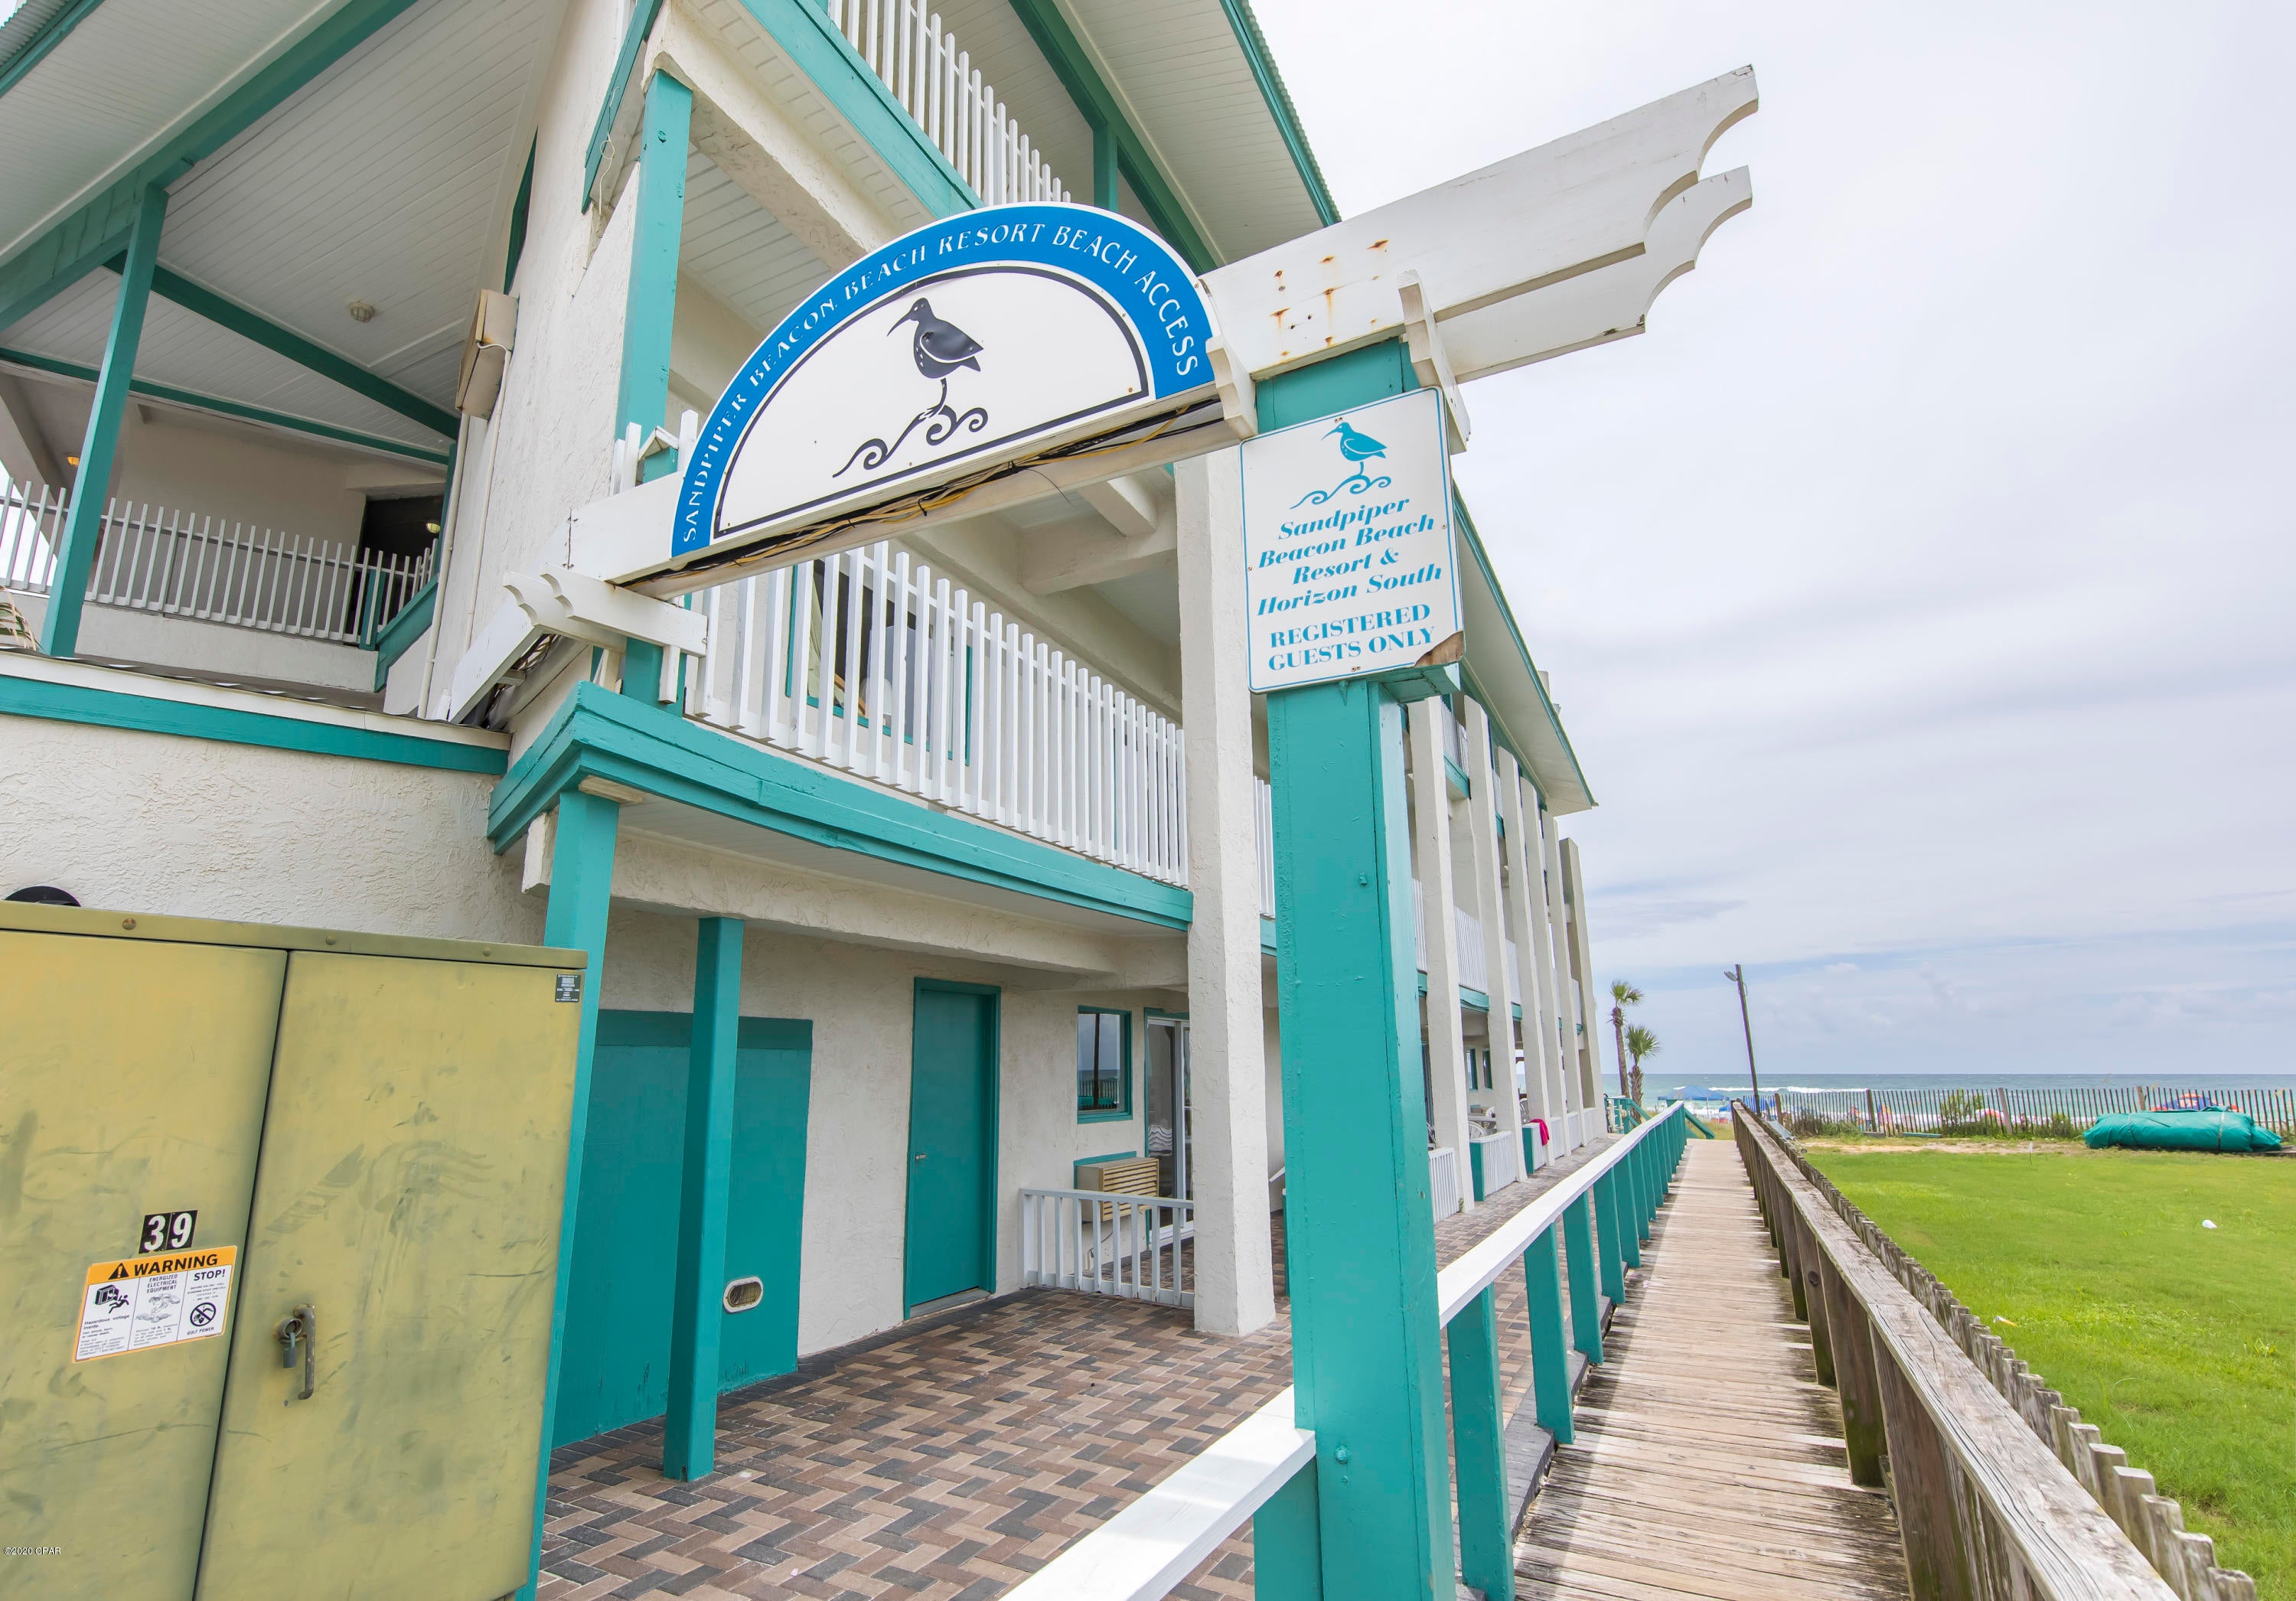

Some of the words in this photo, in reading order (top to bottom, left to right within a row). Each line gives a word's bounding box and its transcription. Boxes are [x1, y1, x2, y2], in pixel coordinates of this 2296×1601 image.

[683, 393, 747, 543] SANDPIPER
[749, 297, 835, 386] BEACON
[845, 245, 925, 301] BEACH
[938, 223, 1047, 256] RESORT
[1052, 225, 1138, 276] BEACH
[1134, 269, 1199, 377] ACCESS
[1278, 497, 1411, 540] Sandpiper
[1258, 536, 1346, 569] Beacon
[1355, 514, 1434, 547] Beach
[1292, 552, 1372, 585] Resort
[1379, 546, 1400, 566] &
[1257, 584, 1358, 617] Horizon
[1365, 562, 1443, 594] South
[1270, 603, 1431, 648] REGISTERED
[1268, 641, 1362, 671] GUESTS
[1368, 625, 1435, 654] ONLY
[143, 1212, 193, 1252] 39
[134, 1254, 218, 1277] WARNING
[147, 1279, 178, 1289] ELECTRICAL
[148, 1273, 178, 1283] ENERGIZED
[194, 1269, 226, 1281] STOP!
[146, 1284, 178, 1293] EQUIPMENT
